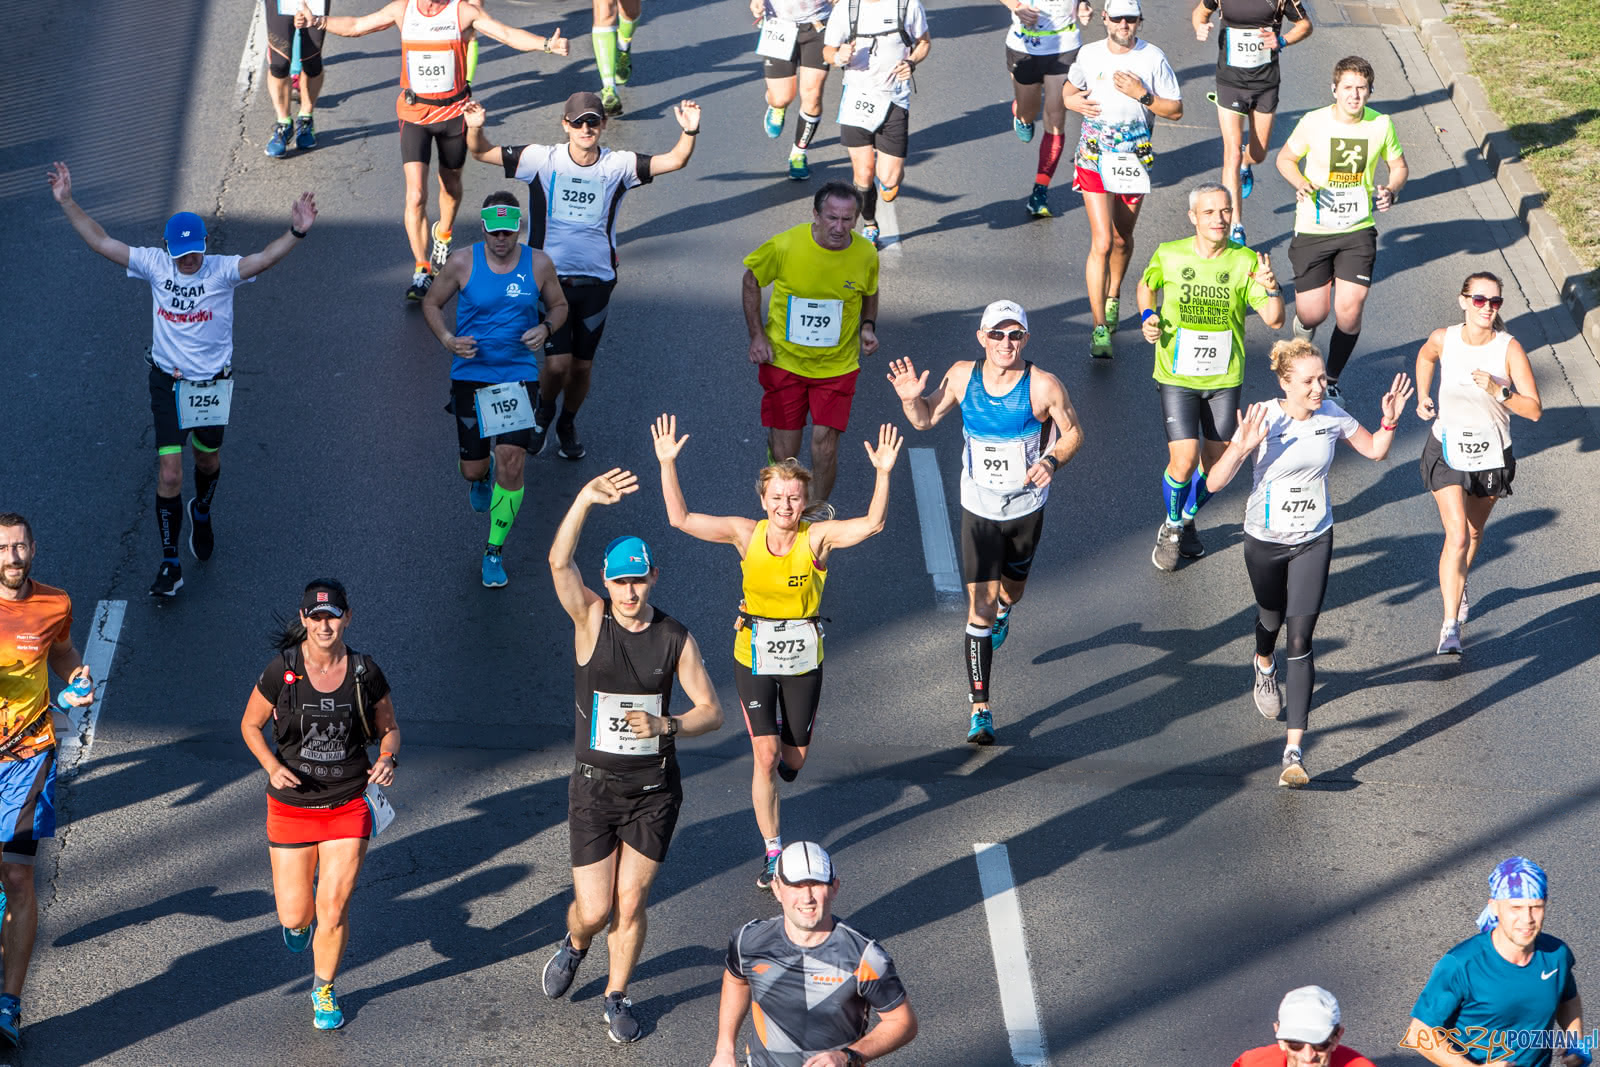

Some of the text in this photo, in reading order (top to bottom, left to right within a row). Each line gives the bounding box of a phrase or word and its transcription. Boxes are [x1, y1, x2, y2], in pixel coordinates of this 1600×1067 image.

[417, 65, 446, 76] 5681
[855, 100, 876, 114] 893
[1111, 166, 1141, 178] 1456
[562, 189, 596, 205] 3289
[1330, 202, 1358, 214] 4571
[1192, 285, 1230, 300] CROSS
[172, 298, 195, 311] DLA
[1179, 304, 1221, 317] BASTER-RUN
[800, 315, 831, 328] 1739
[1194, 347, 1217, 359] 778
[188, 395, 219, 408] 1254
[491, 398, 519, 415] 1159
[1458, 441, 1490, 455] 1329
[983, 459, 1009, 471] 991
[1281, 499, 1316, 513] 4774
[766, 639, 806, 654] 2973
[619, 735, 638, 743] Szymo
